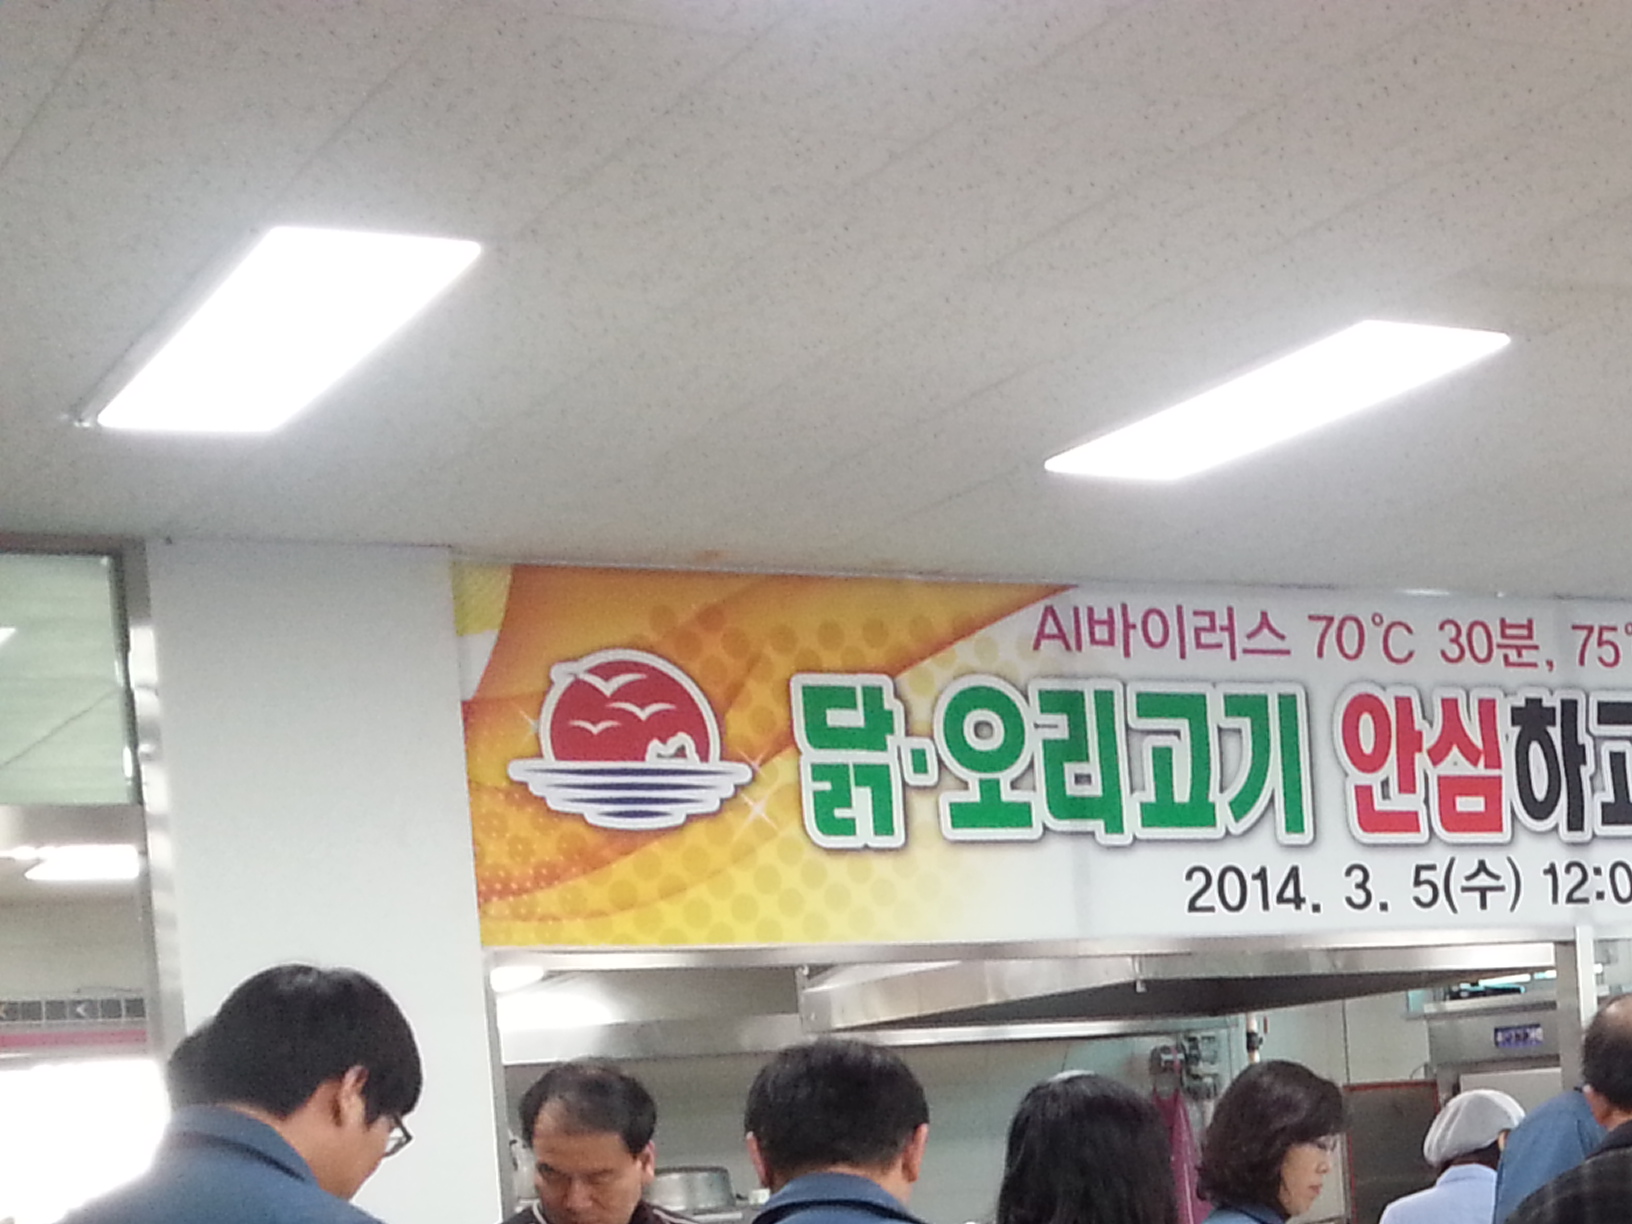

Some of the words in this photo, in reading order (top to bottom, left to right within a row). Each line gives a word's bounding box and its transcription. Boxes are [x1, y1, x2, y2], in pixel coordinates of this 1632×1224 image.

[1032, 603, 1291, 661] AI바이러스
[1438, 617, 1556, 672] 30분,
[1184, 863, 1322, 914] 2014.
[1343, 862, 1390, 913] 3.
[1411, 855, 1523, 915] 5(수)
